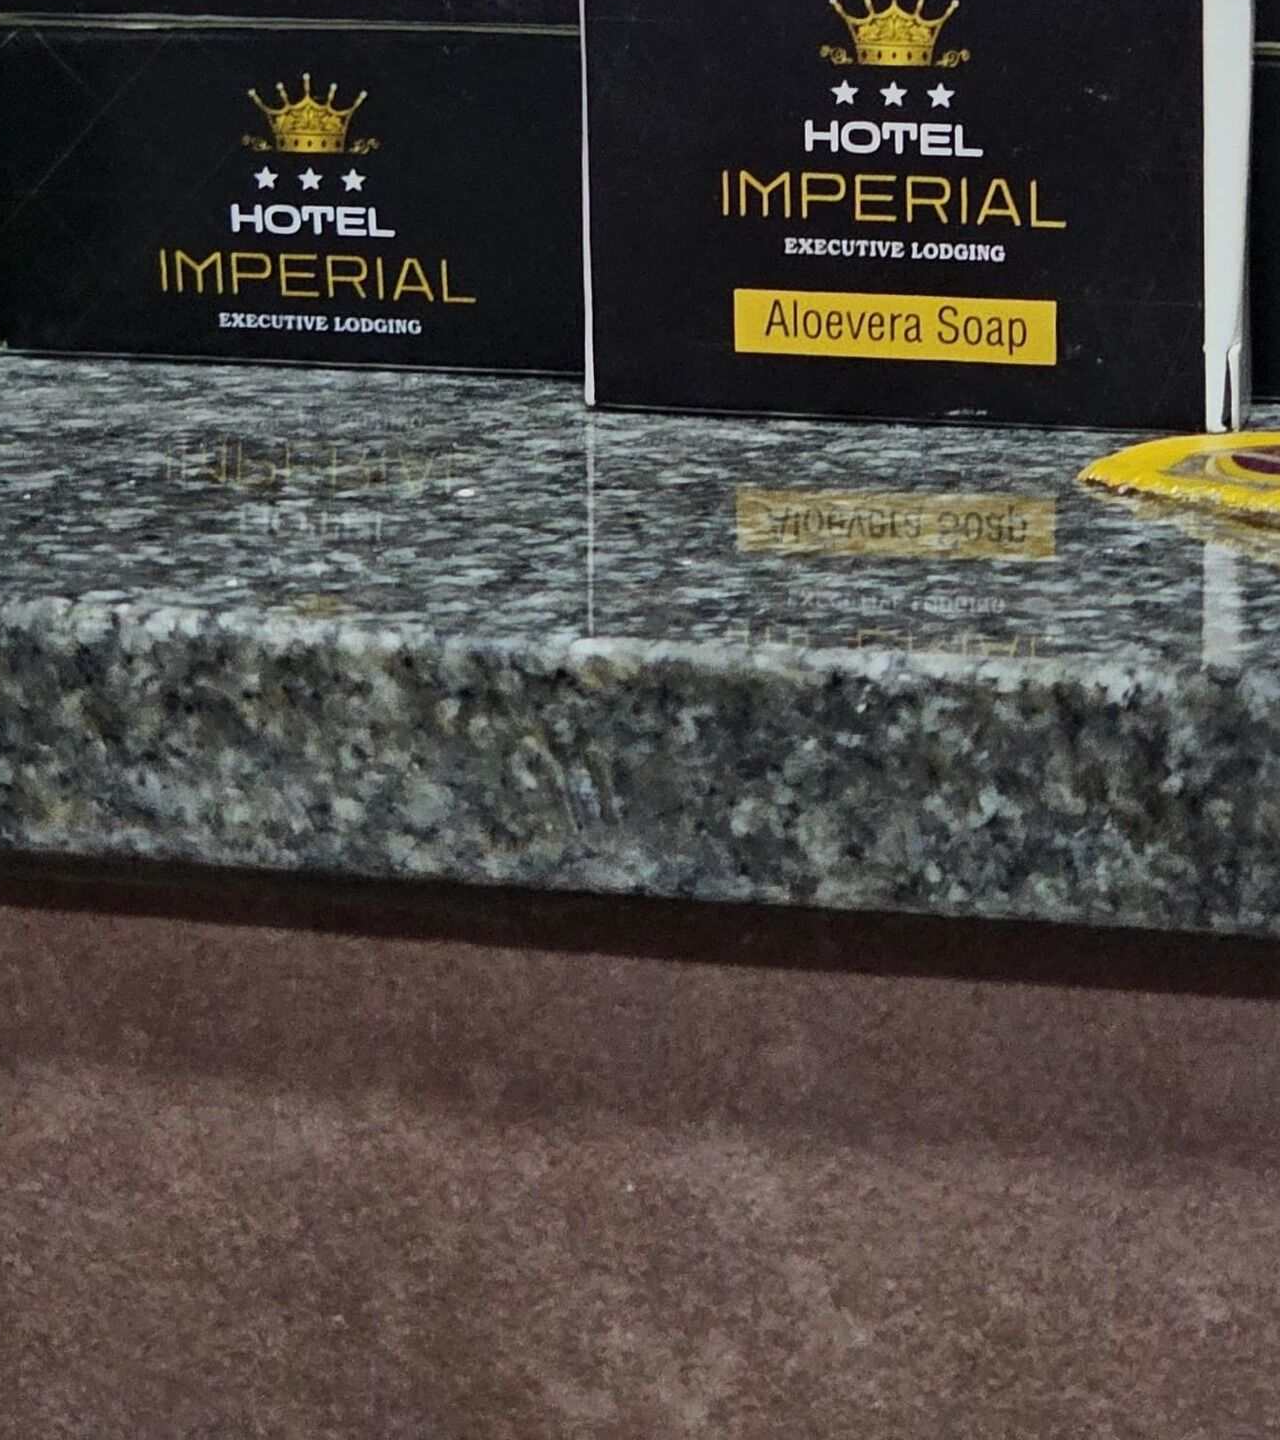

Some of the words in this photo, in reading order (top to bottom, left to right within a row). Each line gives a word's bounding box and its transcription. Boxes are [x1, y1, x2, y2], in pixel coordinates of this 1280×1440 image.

[804, 119, 983, 157] HOTEL
[722, 169, 1066, 228] IMPERIAL
[230, 203, 396, 238] HOTEL
[784, 238, 905, 258] EXECUTIVE
[911, 242, 1005, 262] LODGING
[160, 248, 477, 304] IMPERIAL
[218, 312, 329, 333] EXECUTIVE
[334, 315, 422, 336] LODGING
[765, 299, 922, 343] Aloevera
[937, 305, 1027, 354] Soap
